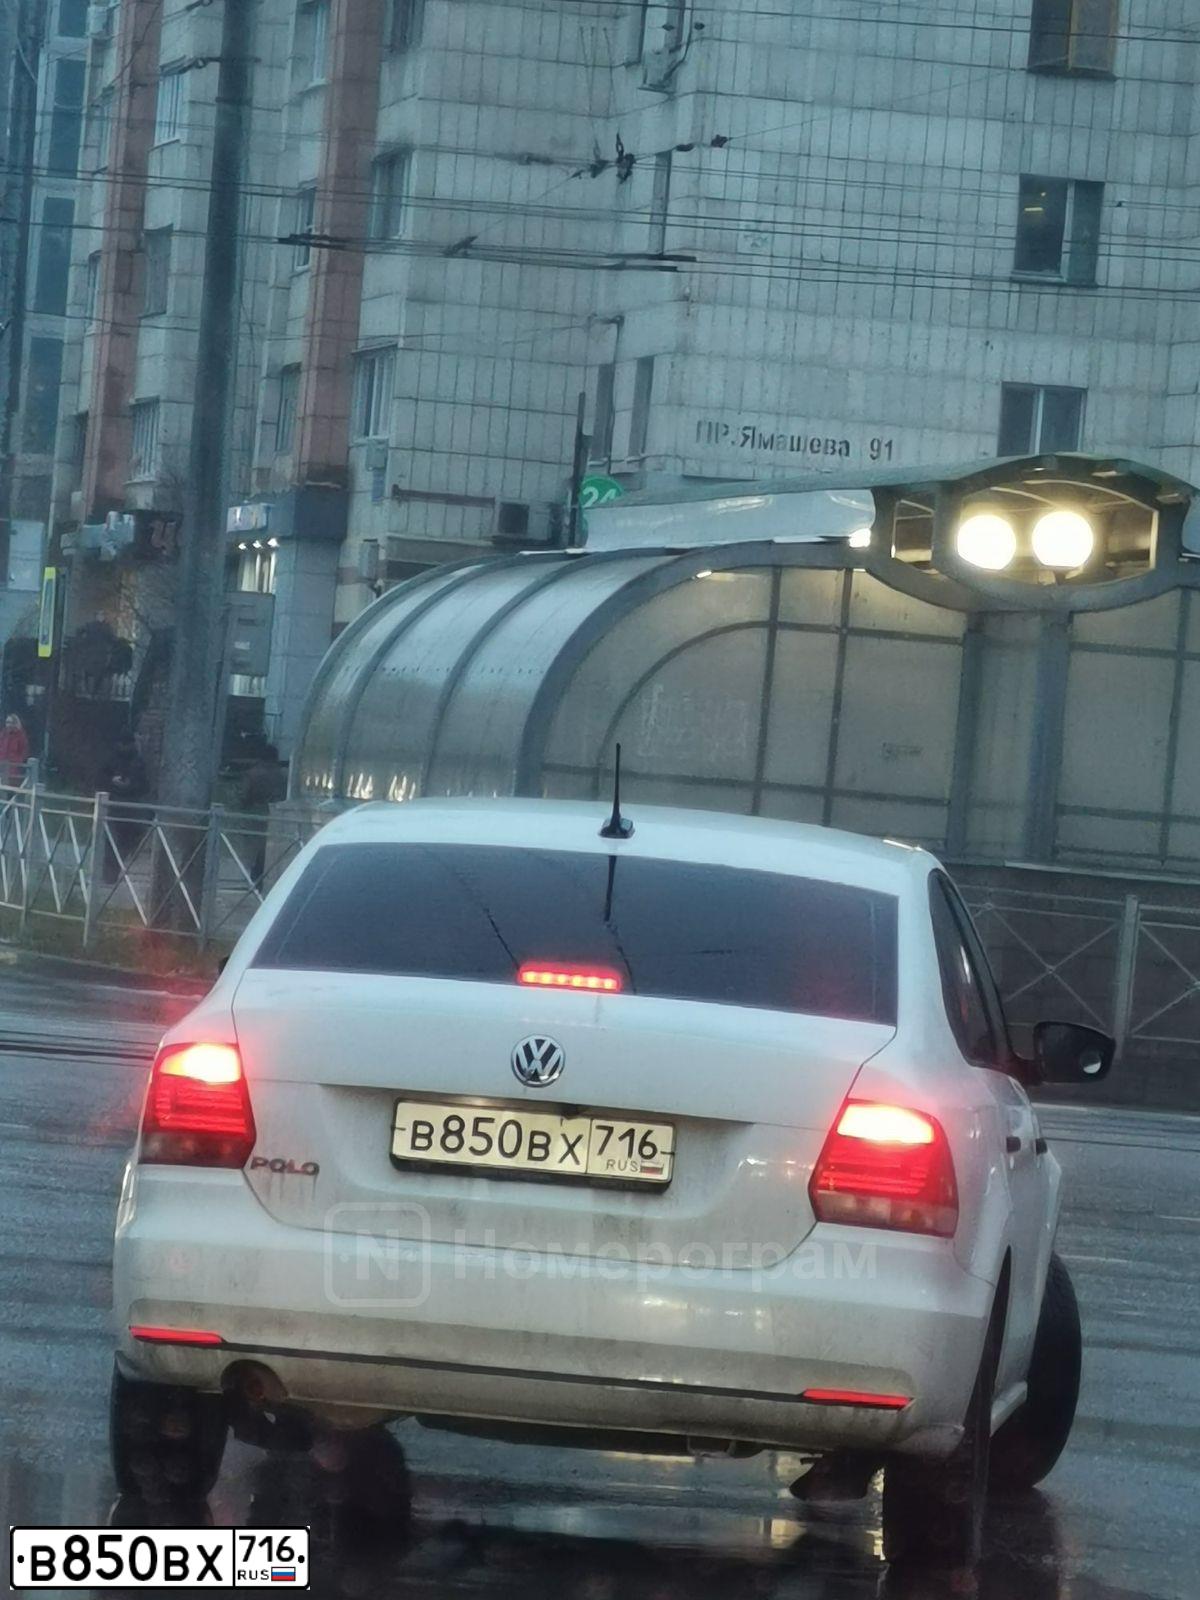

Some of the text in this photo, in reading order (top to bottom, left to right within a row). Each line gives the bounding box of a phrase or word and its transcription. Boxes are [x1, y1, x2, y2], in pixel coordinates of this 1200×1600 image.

[869, 437, 894, 462] 91
[410, 1114, 658, 1165] В850ВХ 716
[250, 1156, 320, 1175] POLO
[605, 1158, 638, 1172] RUS
